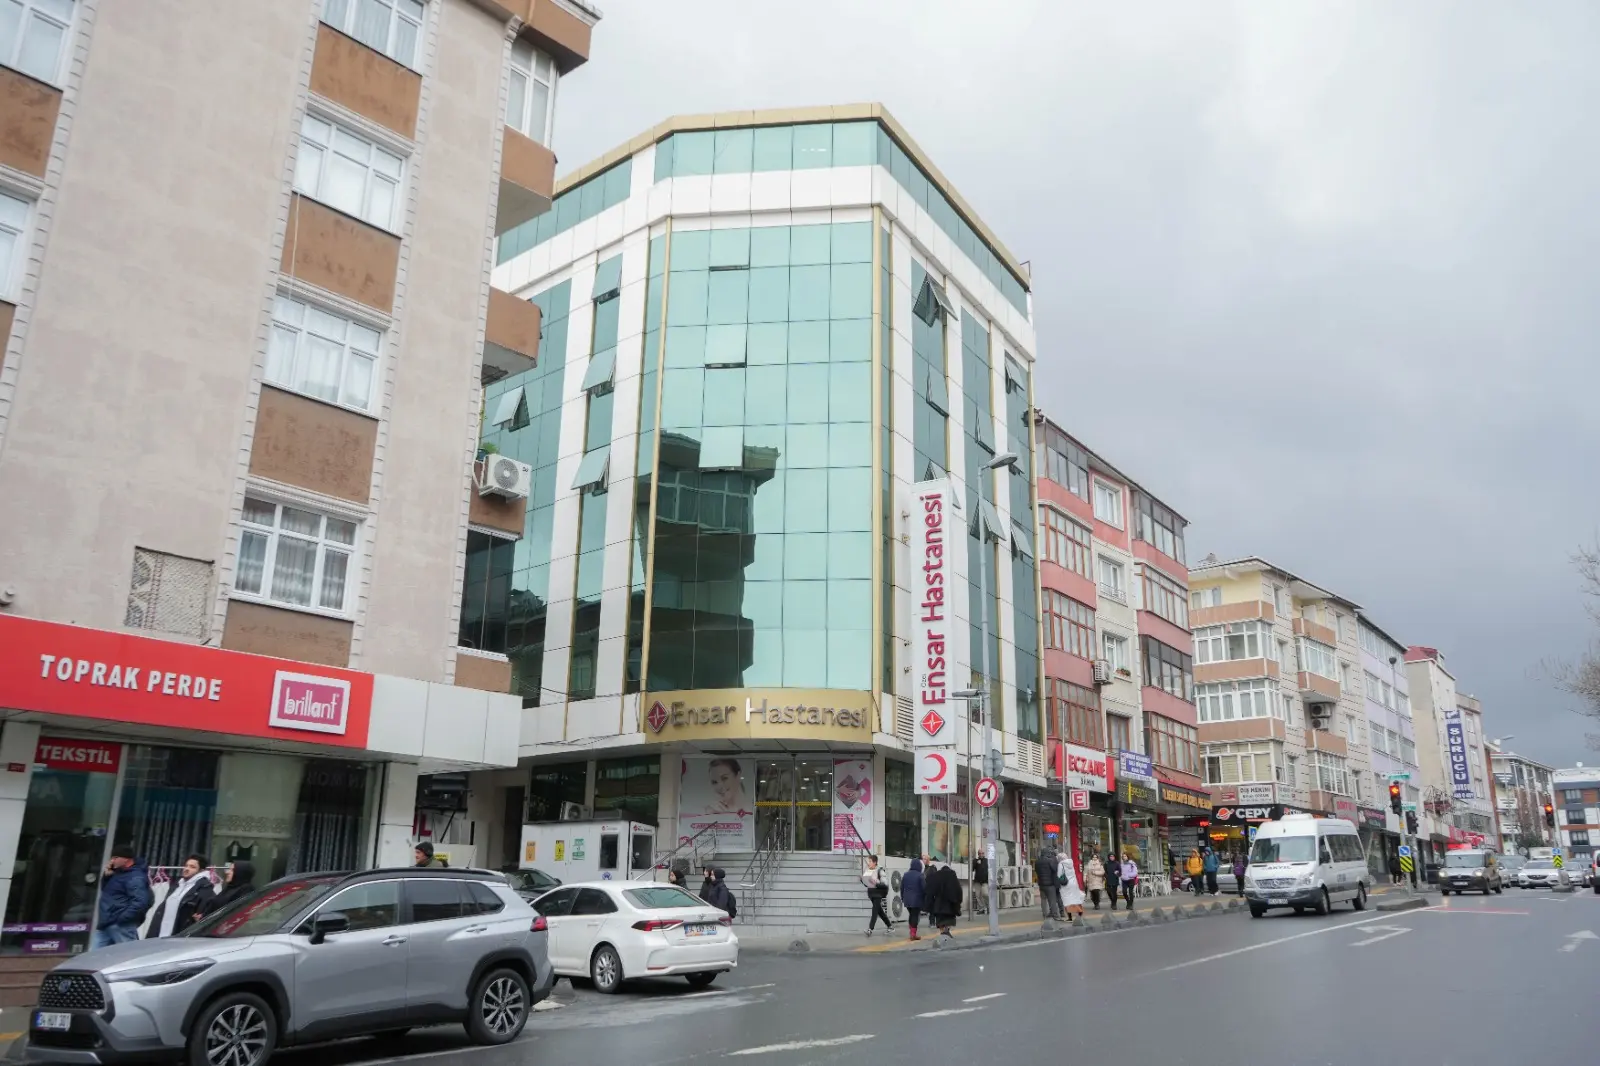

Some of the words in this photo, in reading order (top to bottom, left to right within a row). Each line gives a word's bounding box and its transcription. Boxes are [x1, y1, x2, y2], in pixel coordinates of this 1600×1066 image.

[920, 493, 944, 623] Hastanesi
[40, 654, 140, 690] TOPRAK
[147, 670, 222, 701] PERDE
[921, 629, 946, 706] Ensar
[285, 687, 338, 721] brillant
[671, 701, 737, 727] Ensar
[745, 698, 867, 729] Hastanesi
[40, 745, 113, 765] TEKSTİL
[1068, 754, 1106, 778] ECZANE
[1449, 727, 1467, 781] SÜRÜCÜ
[1074, 792, 1084, 806] E
[1235, 807, 1271, 819] CEPY
